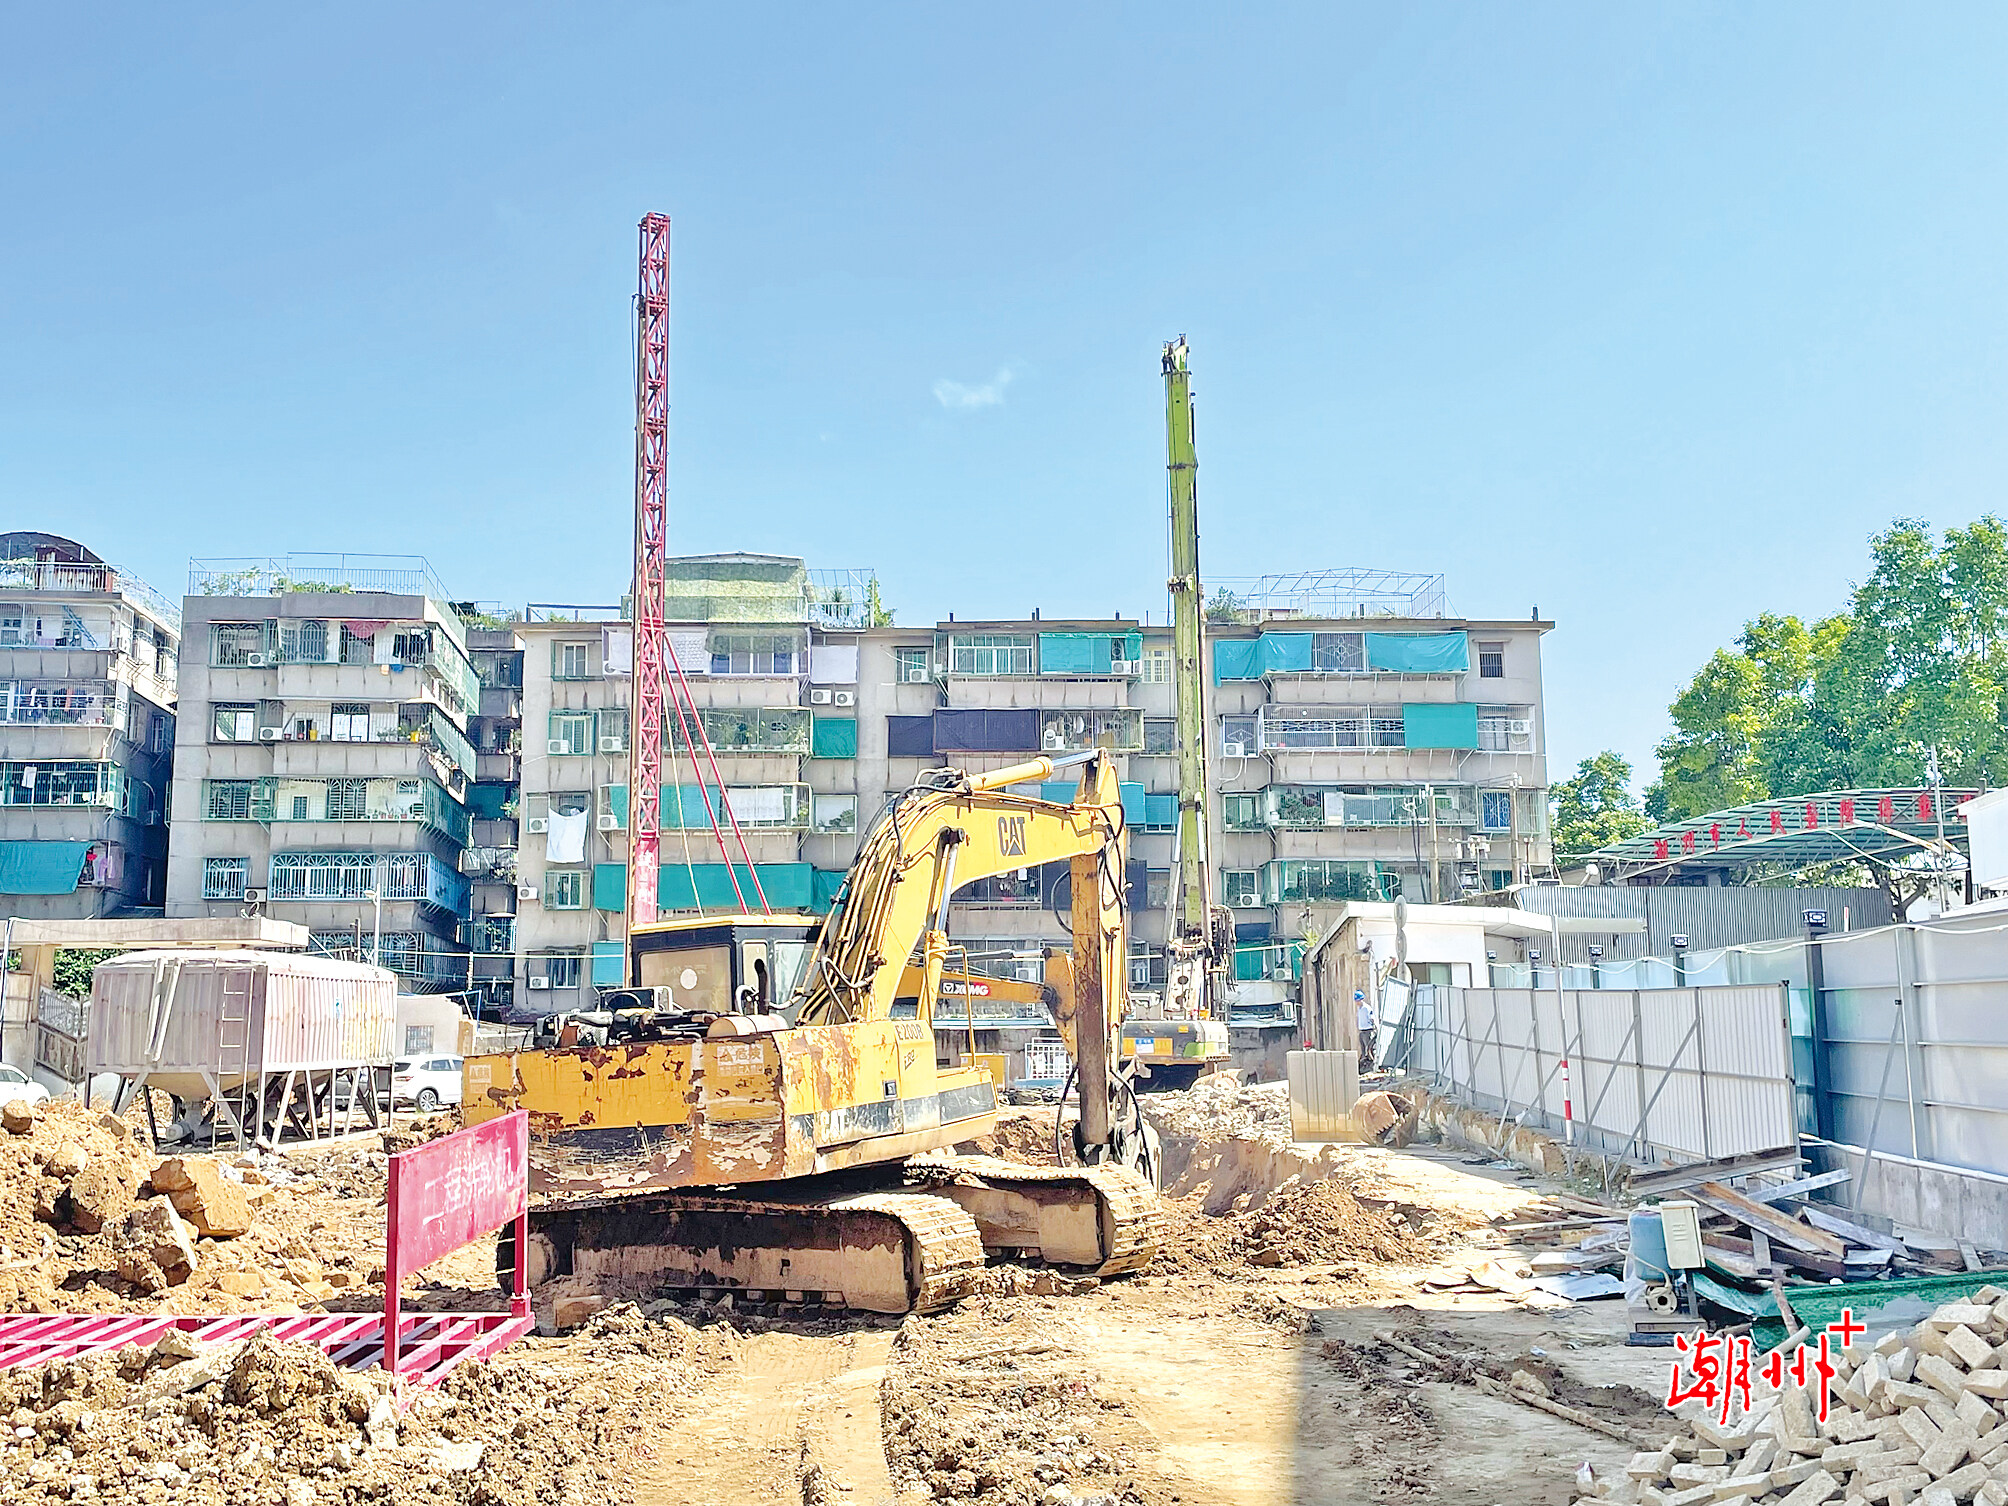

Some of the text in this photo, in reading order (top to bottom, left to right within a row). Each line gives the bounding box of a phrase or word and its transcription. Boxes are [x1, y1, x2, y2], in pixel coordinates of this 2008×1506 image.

[998, 817, 1026, 856] CAT
[895, 1024, 924, 1040] E200B
[820, 1110, 847, 1142] CAT
